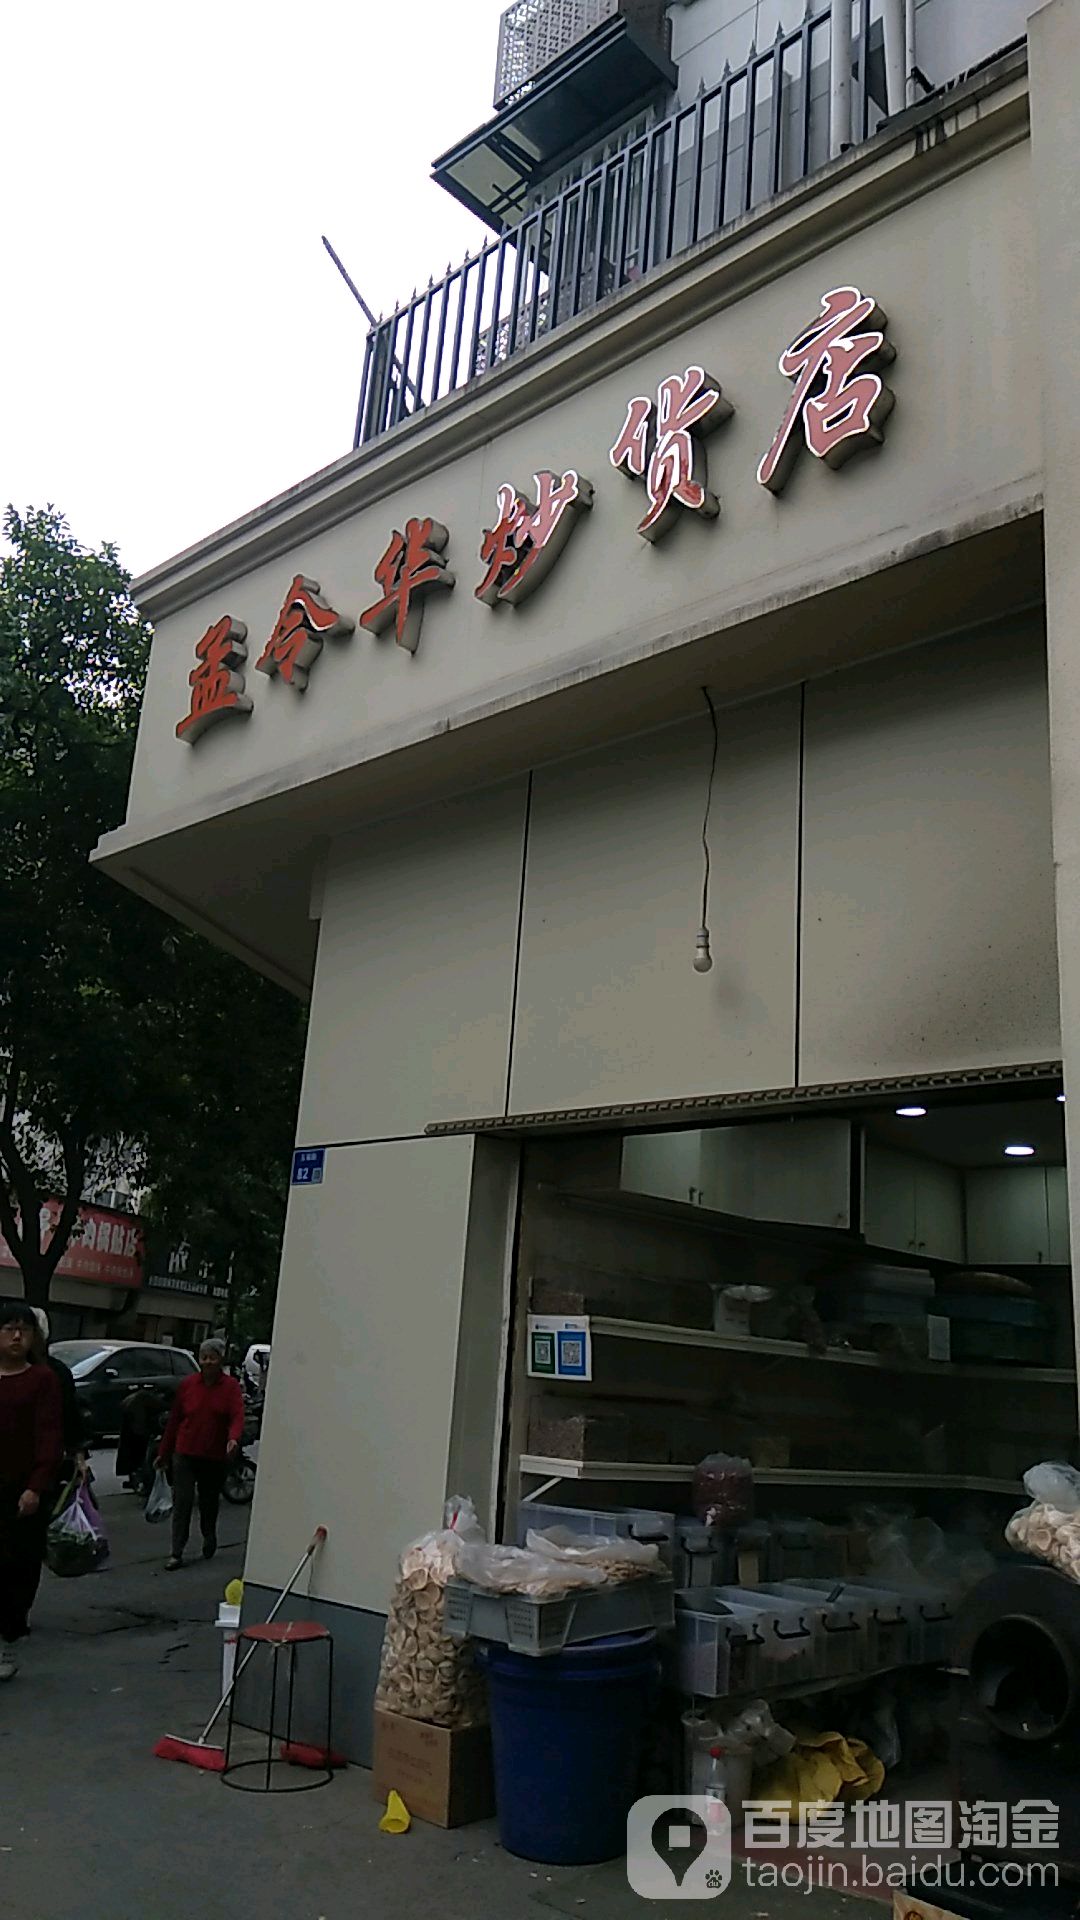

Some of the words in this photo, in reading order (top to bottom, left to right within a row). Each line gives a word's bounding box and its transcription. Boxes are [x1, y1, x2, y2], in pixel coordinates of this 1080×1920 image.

[175, 285, 891, 742] 孟令华炒货店
